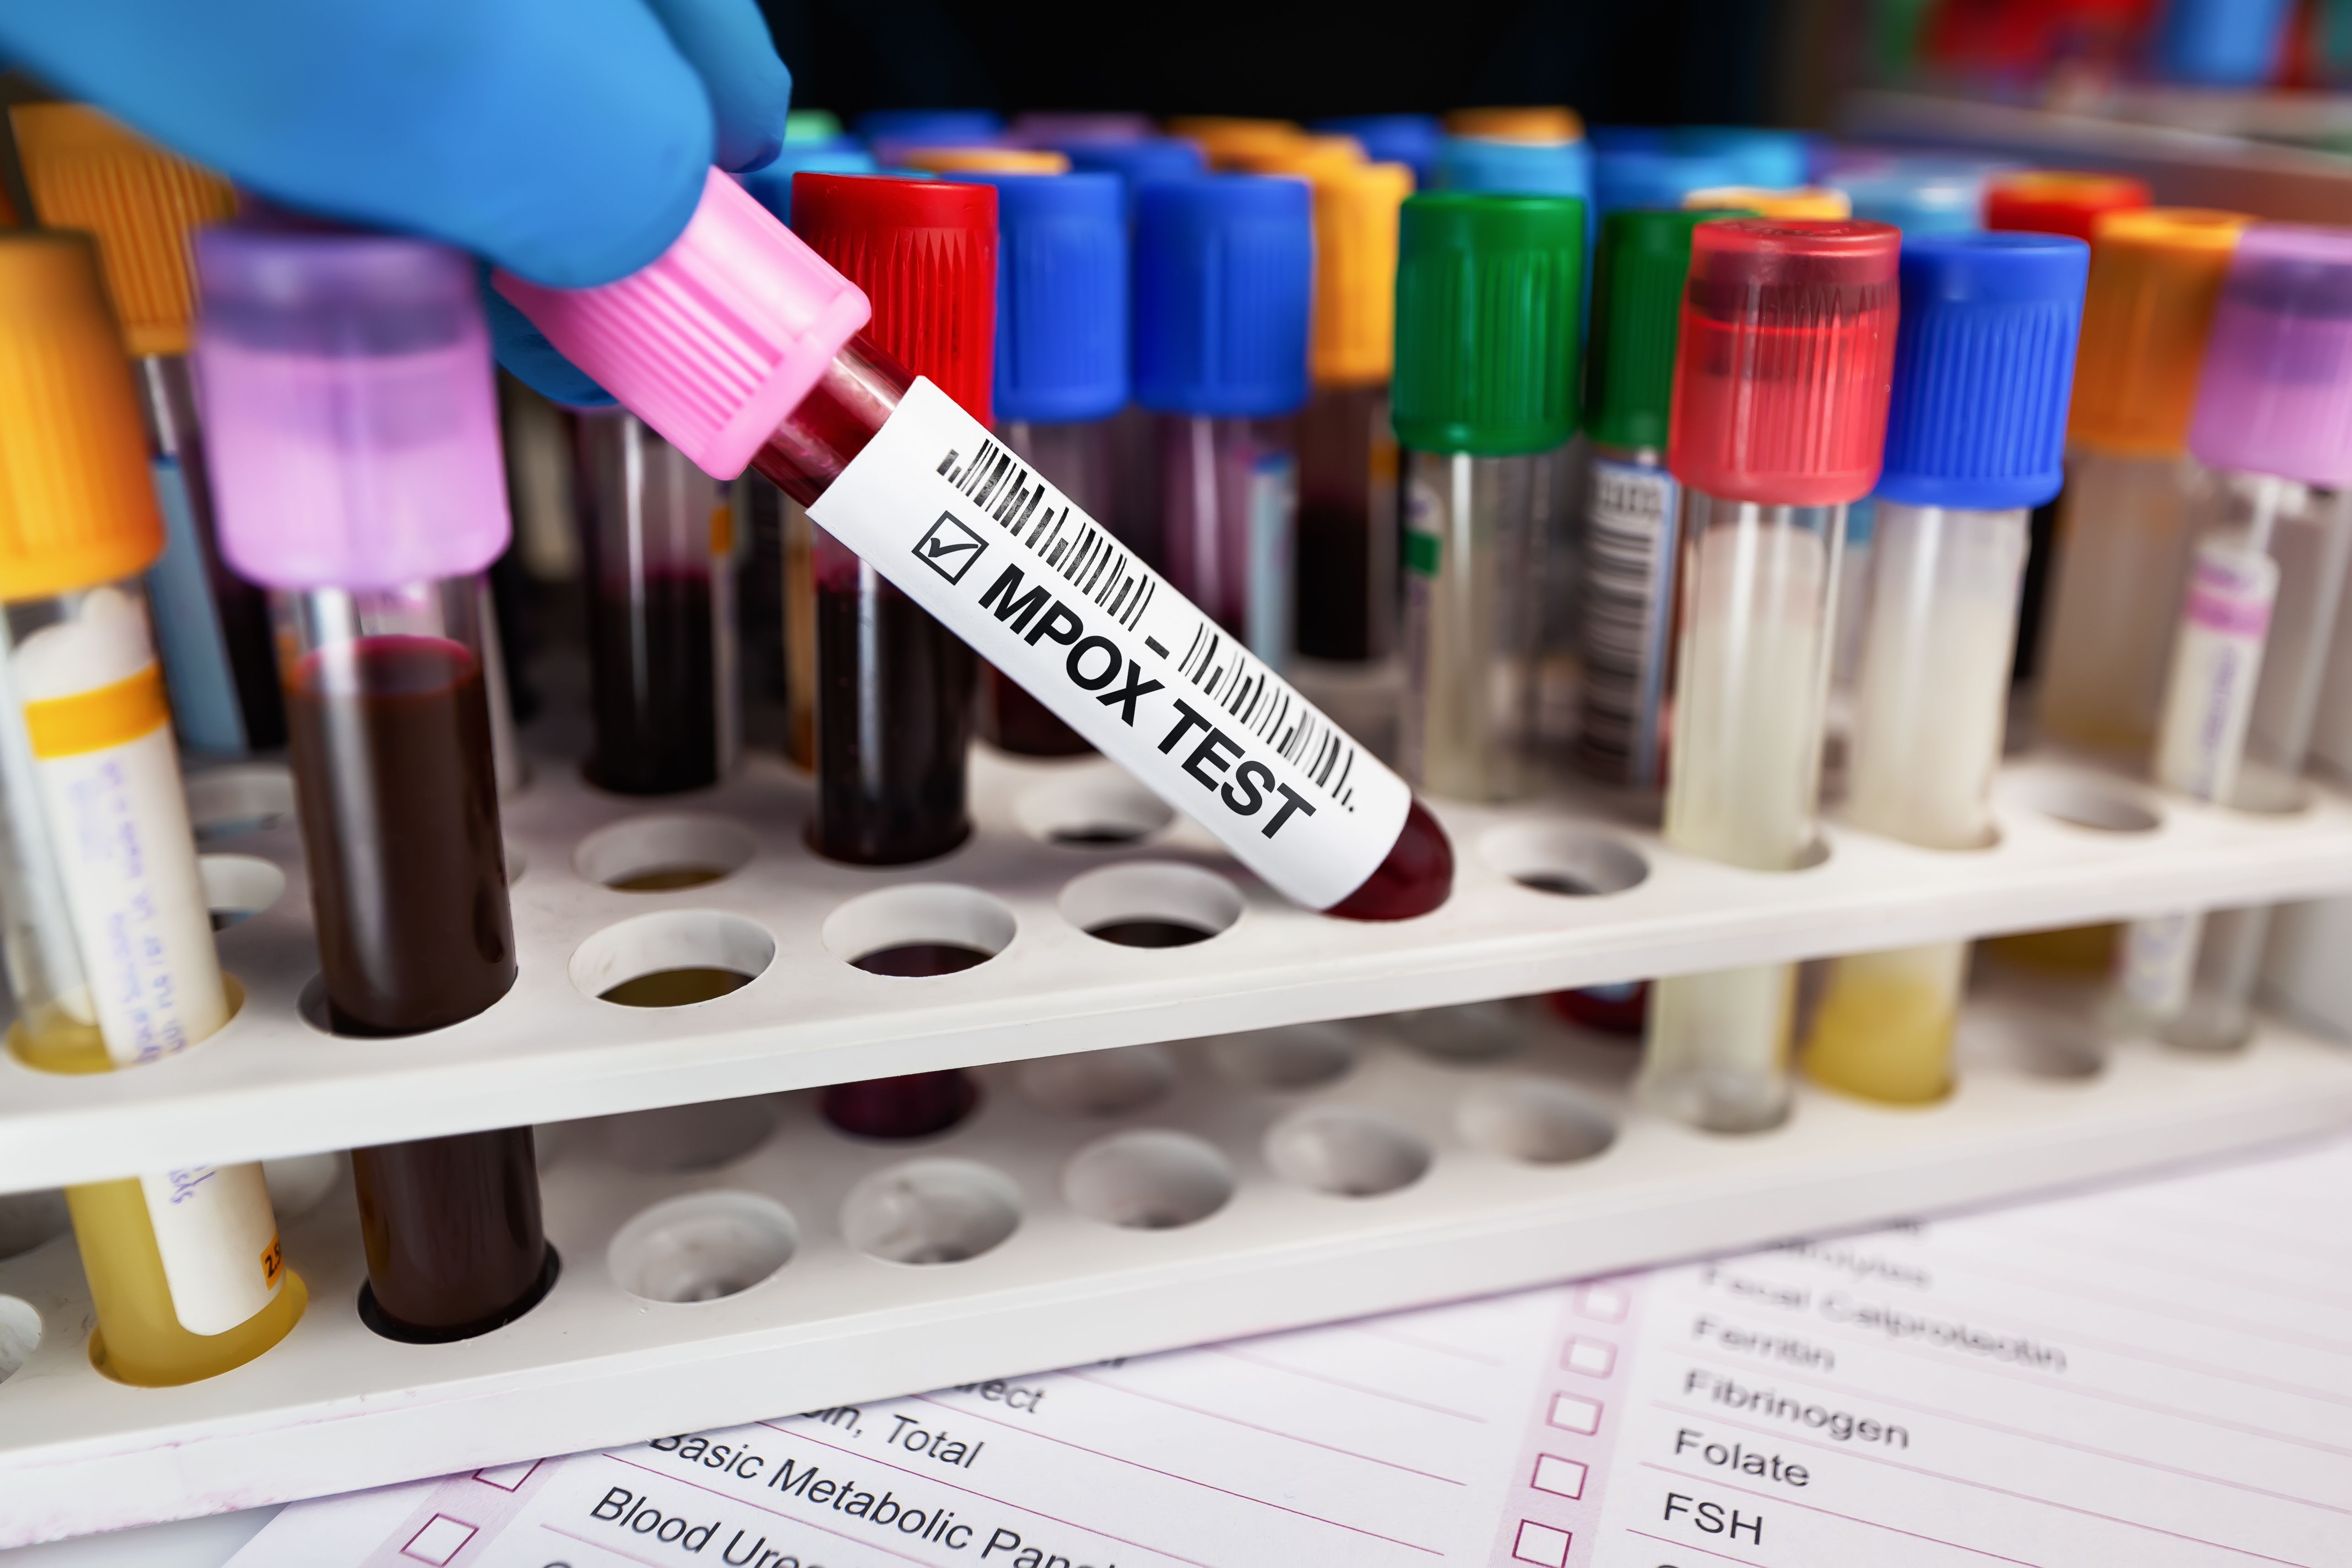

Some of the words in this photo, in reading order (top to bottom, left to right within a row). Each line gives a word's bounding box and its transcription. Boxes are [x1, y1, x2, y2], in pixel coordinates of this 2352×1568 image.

[978, 563, 1165, 727] MPOX
[1157, 698, 1317, 839] TEST
[1691, 1313, 1836, 1373] Ferritin
[1819, 1289, 2067, 1373] Calprotectin
[886, 1414, 985, 1469] Total
[1683, 1369, 1910, 1450] Fibrinogen
[1674, 1428, 1810, 1487] Folate
[590, 1487, 722, 1553] Blood
[768, 1459, 973, 1550] Metabolic
[1663, 1492, 1763, 1546] FSH
